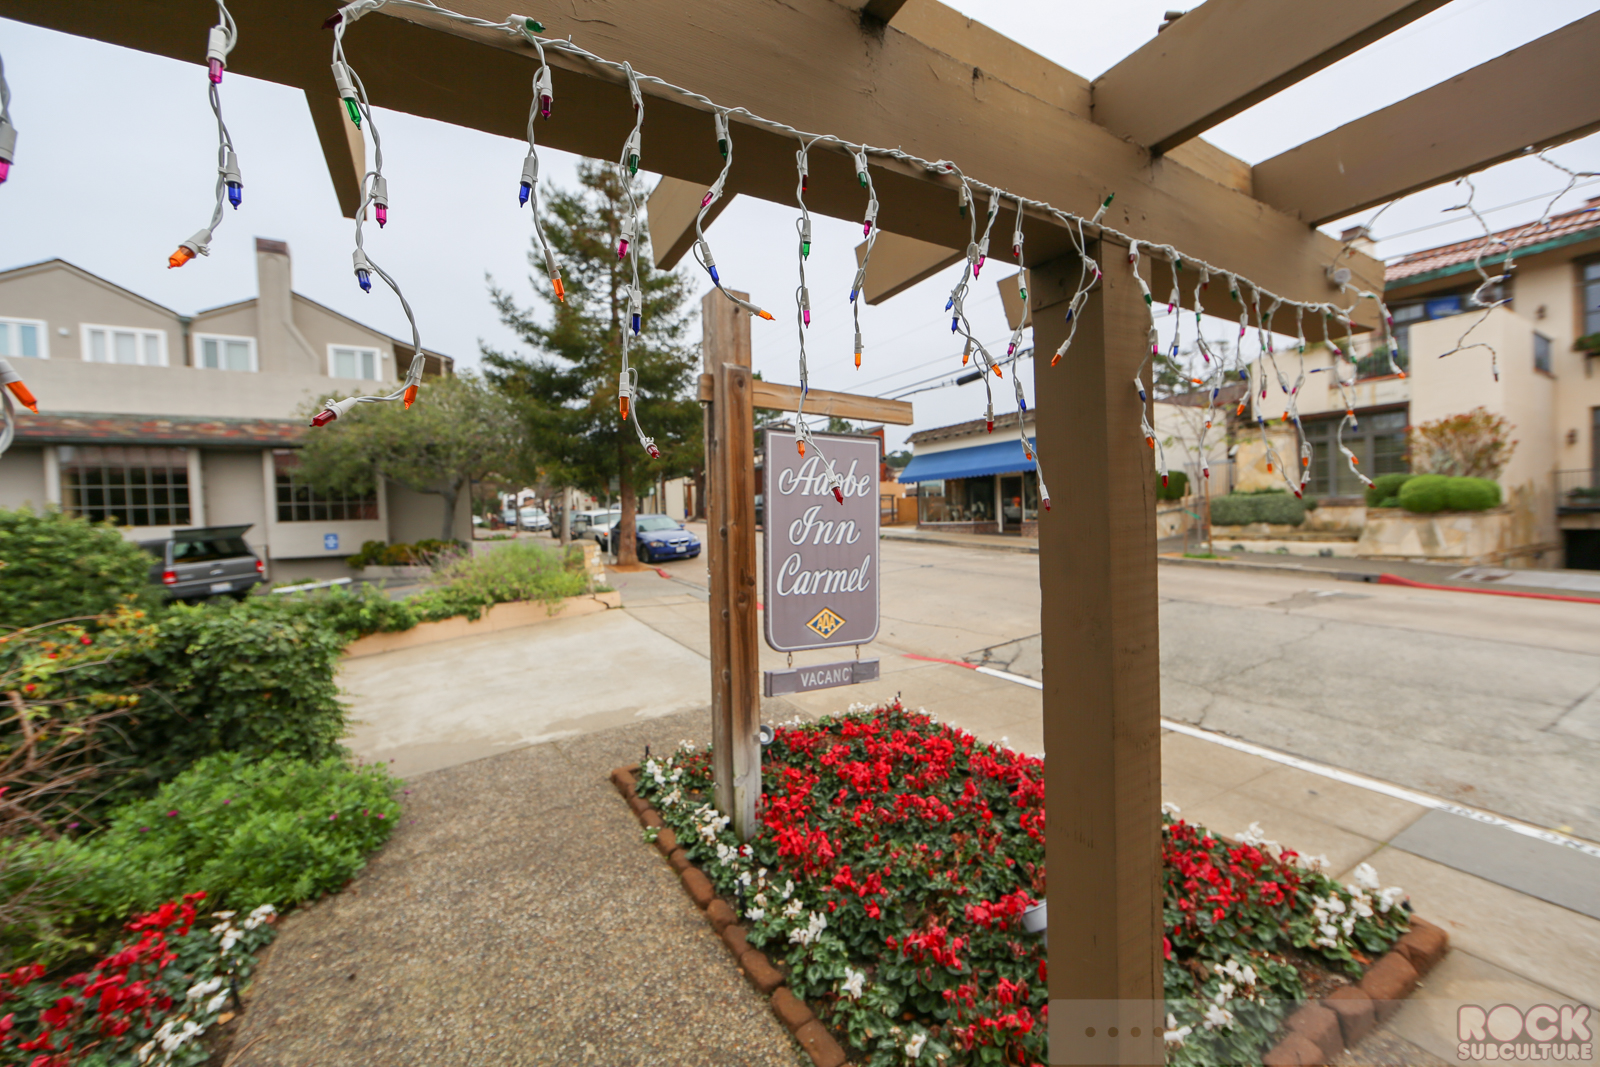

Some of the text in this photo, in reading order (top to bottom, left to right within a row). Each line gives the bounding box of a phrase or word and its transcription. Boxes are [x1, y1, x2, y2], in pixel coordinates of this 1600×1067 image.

[778, 455, 871, 498] Adobe
[788, 504, 860, 546] Inn
[776, 552, 871, 597] Carmel
[816, 612, 837, 632] AAA
